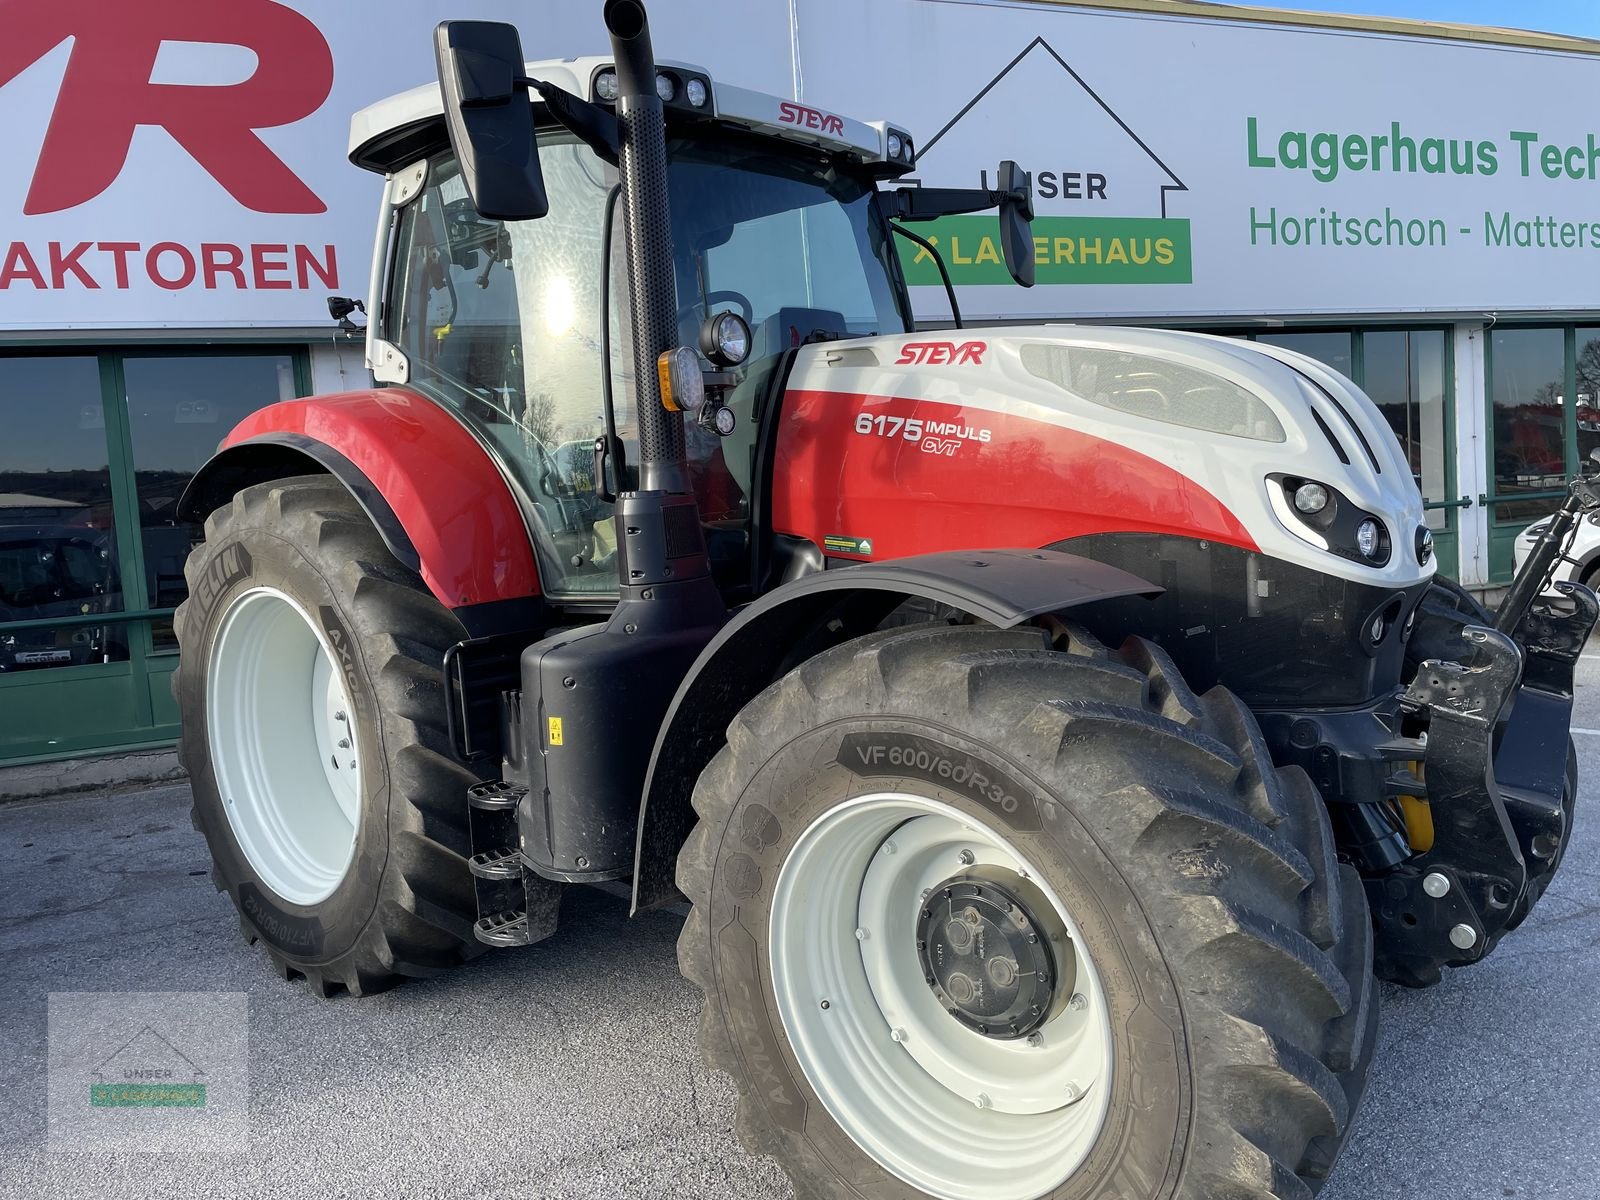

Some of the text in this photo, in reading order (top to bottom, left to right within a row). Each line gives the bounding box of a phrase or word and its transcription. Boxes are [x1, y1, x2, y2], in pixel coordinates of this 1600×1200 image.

[779, 102, 844, 136] STEYR
[1247, 117, 1498, 183] Lagerhaus
[980, 170, 1108, 199] USER
[1250, 207, 1447, 247] Horitschon
[1484, 211, 1600, 249] Matters
[0, 241, 339, 290] AKTOREN
[951, 236, 1175, 265] LAERHAUS
[894, 341, 987, 365] STEYR
[855, 412, 992, 443] 6175 IMPULS
[920, 436, 962, 457] CVT
